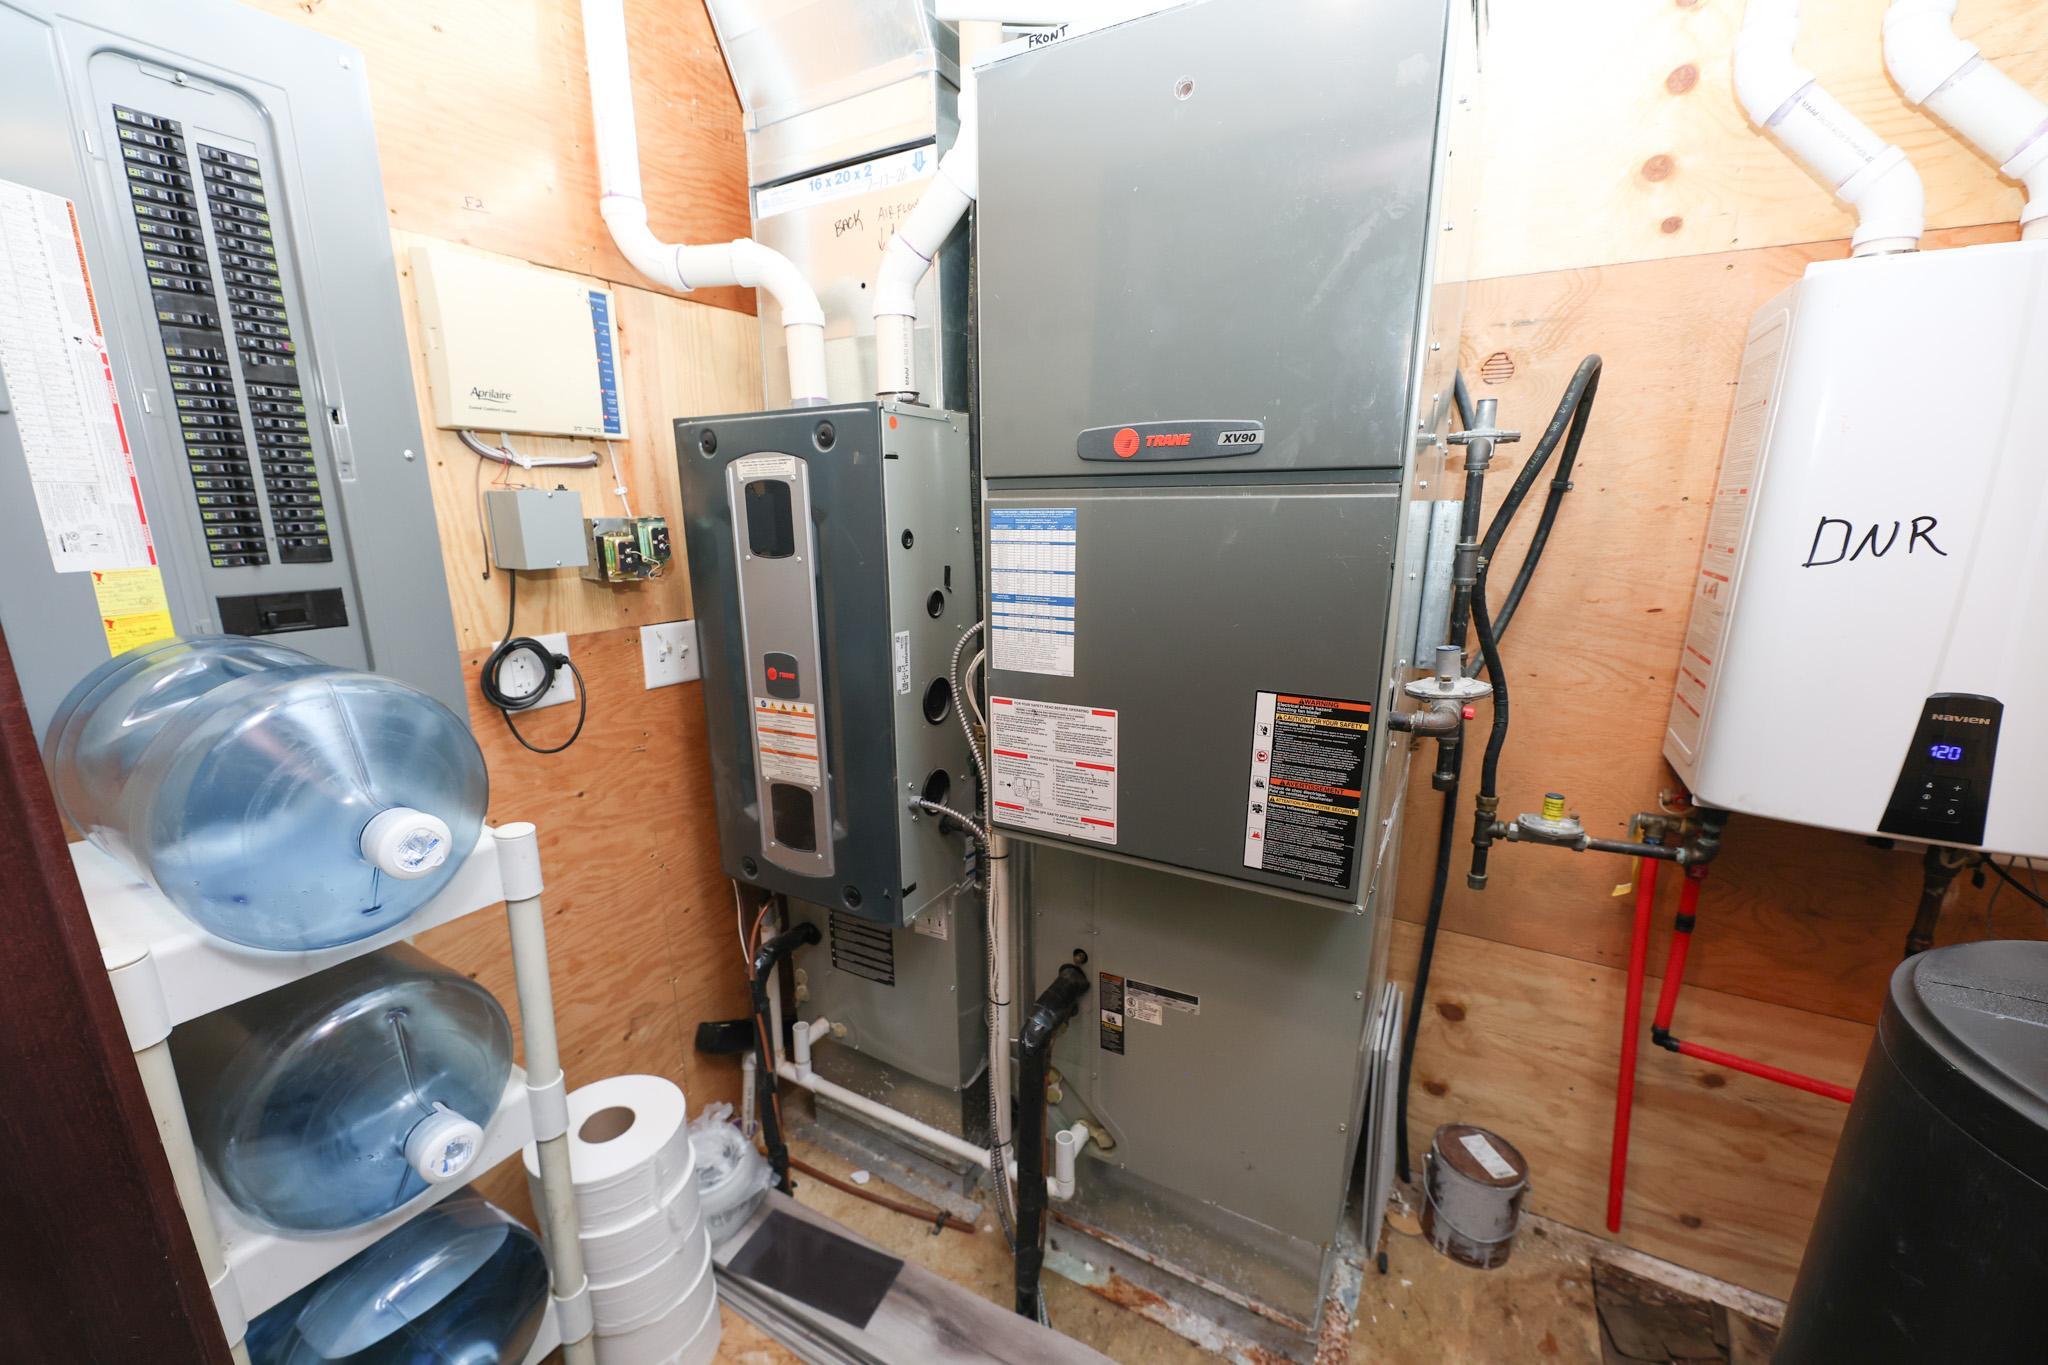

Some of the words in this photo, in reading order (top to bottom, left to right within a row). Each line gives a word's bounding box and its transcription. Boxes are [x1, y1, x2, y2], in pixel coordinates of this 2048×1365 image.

[1029, 24, 1069, 48] FRONT
[809, 178, 822, 192] 16
[825, 179, 832, 187] x
[835, 170, 850, 185] 20
[854, 171, 861, 179] x
[864, 165, 872, 177] 2
[834, 210, 863, 237] BACK
[471, 387, 512, 400] Aprilaire
[1145, 433, 1192, 447] TRANE
[1222, 433, 1256, 443] XV90
[1801, 516, 1948, 568] DNR
[1305, 700, 1339, 708] WARNING
[1322, 718, 1338, 726] YOUR
[1340, 721, 1362, 729] SAFETY
[1930, 745, 1962, 760] 120
